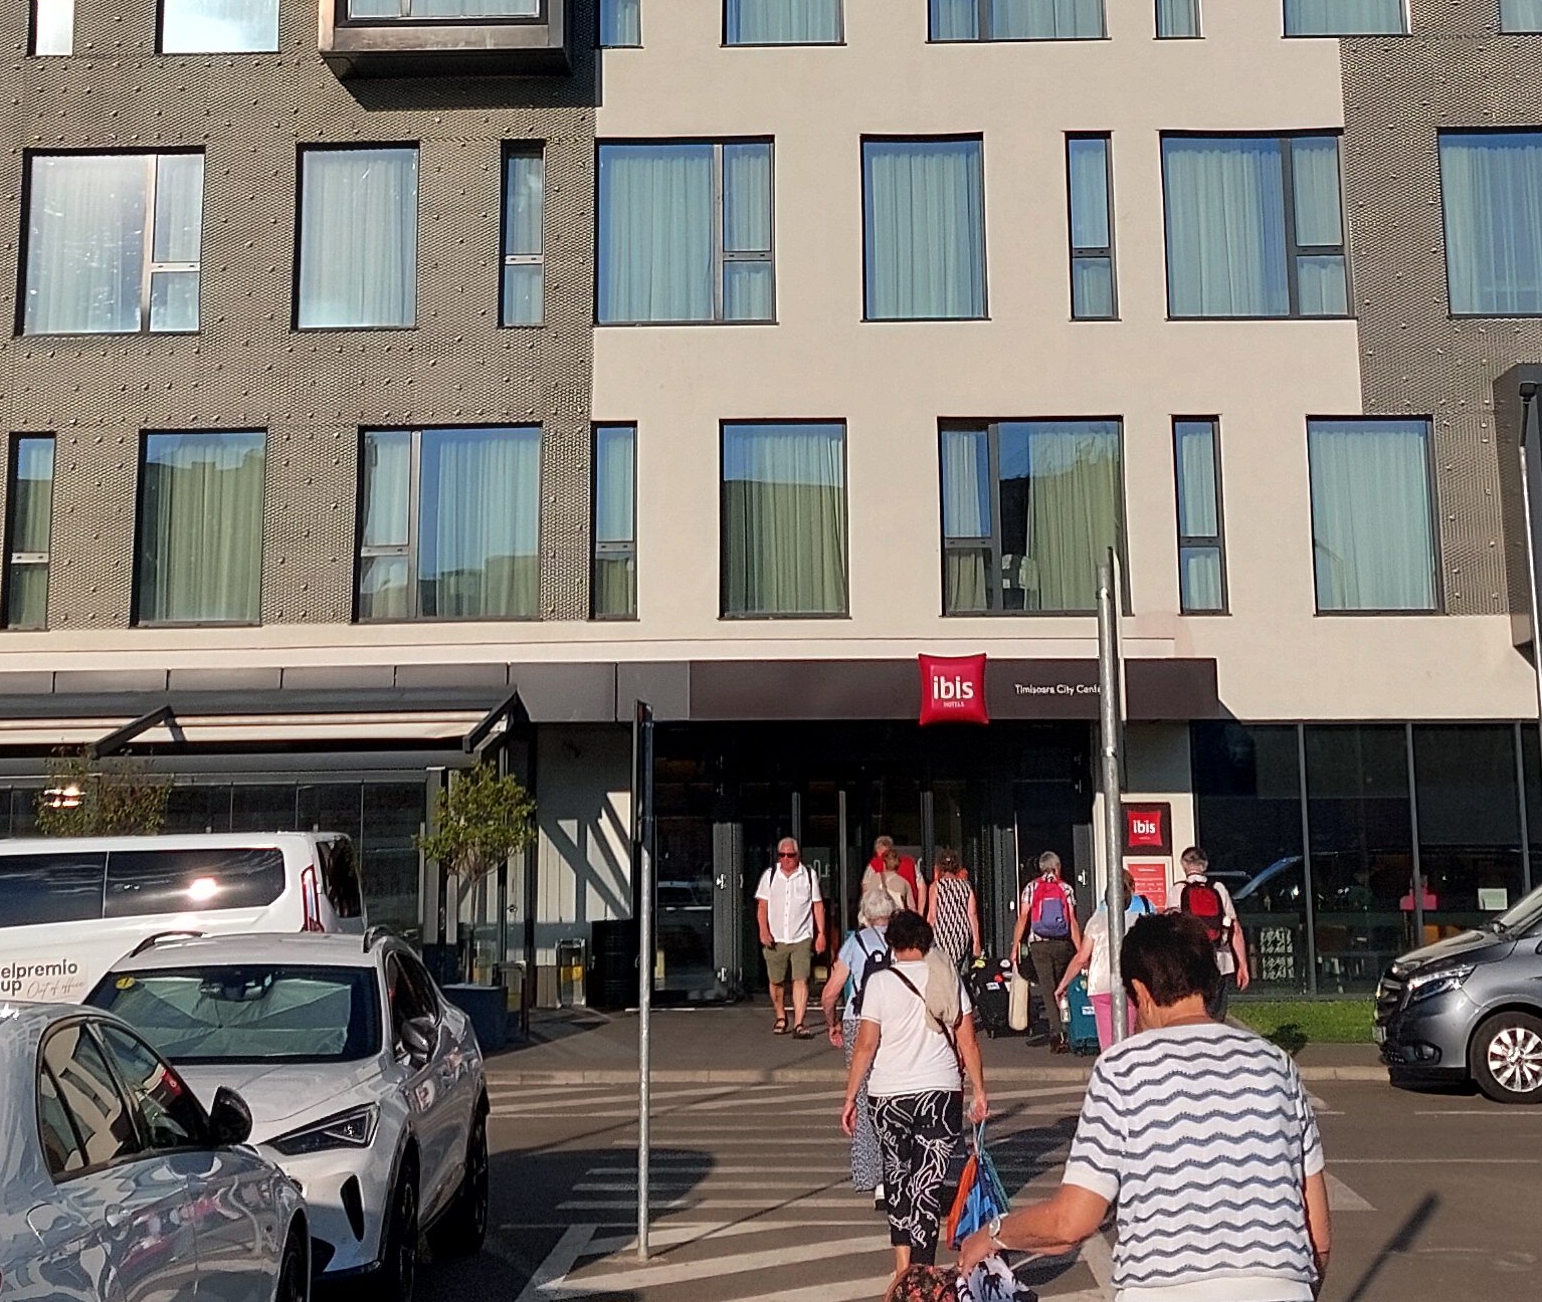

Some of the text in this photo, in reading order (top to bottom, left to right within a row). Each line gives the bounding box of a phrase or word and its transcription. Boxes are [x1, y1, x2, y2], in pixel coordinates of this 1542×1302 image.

[933, 675, 974, 700] ibis
[1056, 683, 1075, 696] City
[1076, 683, 1101, 694] Cent
[1133, 819, 1156, 834] ibis
